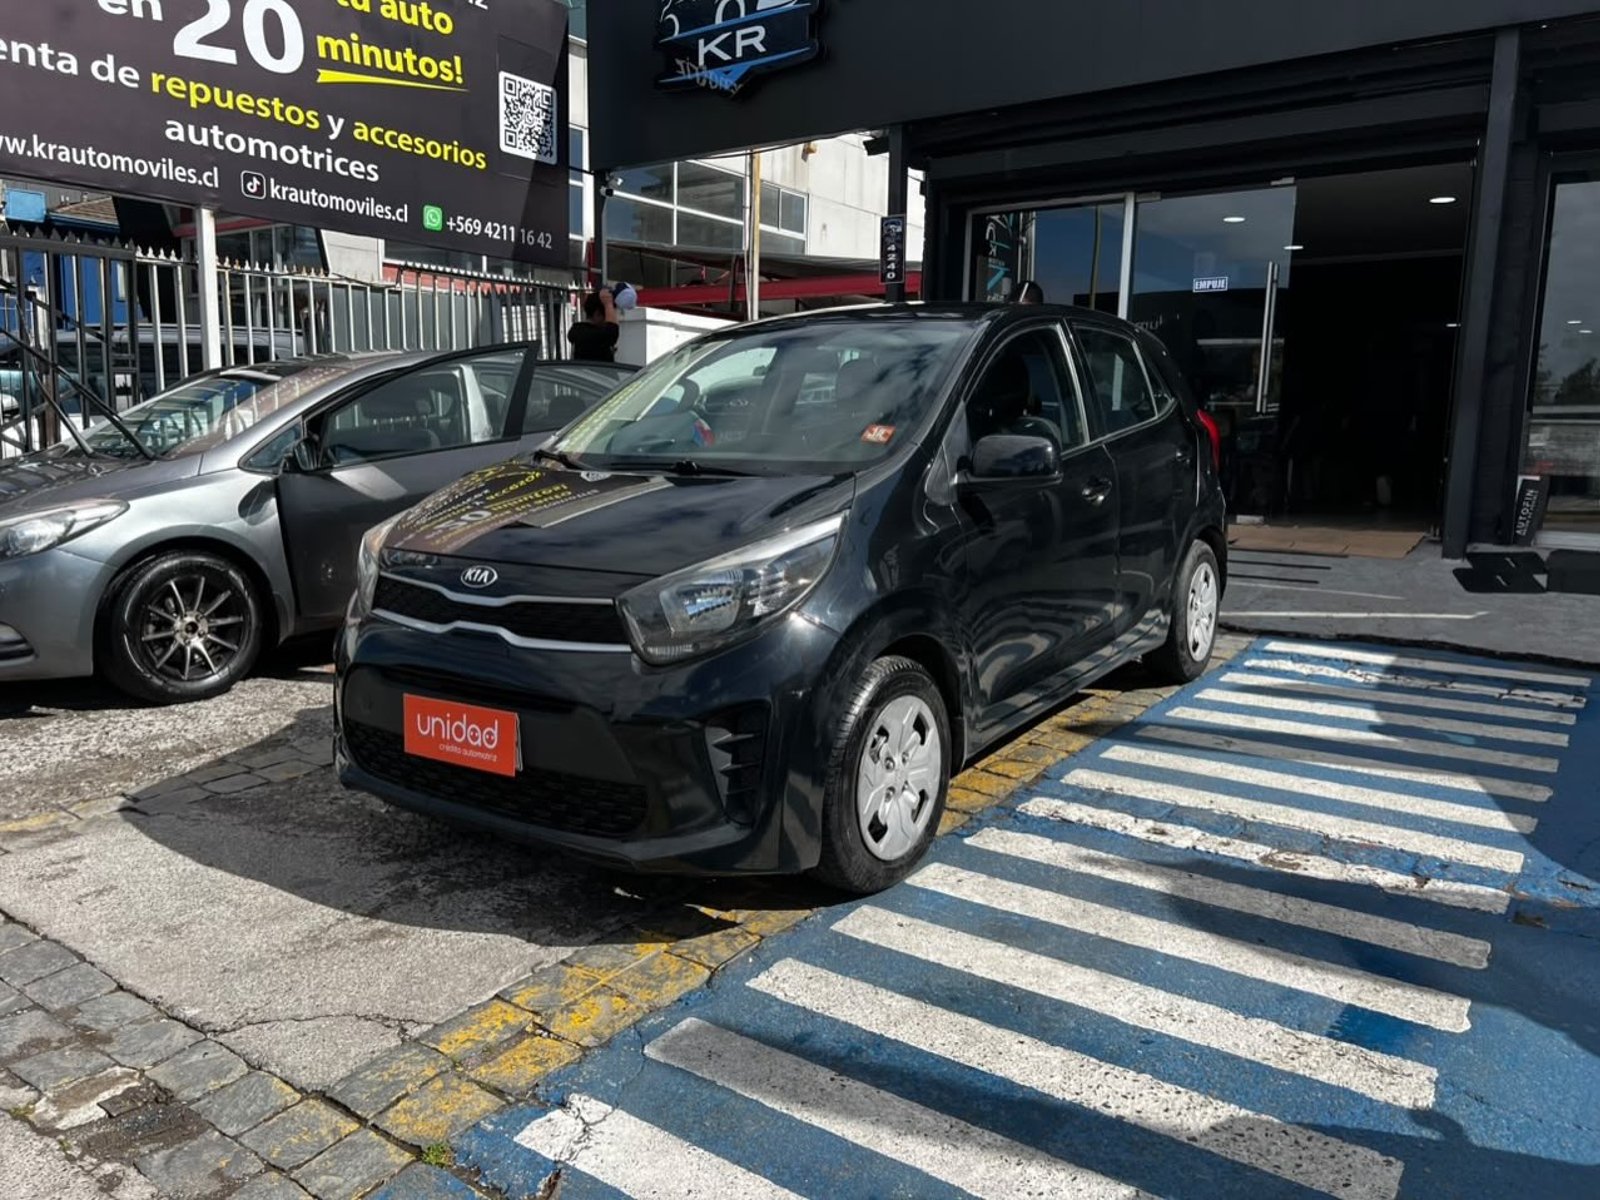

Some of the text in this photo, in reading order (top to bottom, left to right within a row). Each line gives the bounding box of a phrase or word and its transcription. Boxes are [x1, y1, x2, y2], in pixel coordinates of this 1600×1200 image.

[380, 0, 454, 34] auto
[97, 0, 463, 84] en 20 minutos!
[698, 25, 767, 67] KR
[91, 54, 140, 88] de
[151, 72, 320, 129] repuestos
[326, 114, 345, 140] y
[353, 121, 487, 170] accesorios
[0, 133, 219, 188] w.krautomoviles.cl
[165, 120, 379, 182] automotrices
[270, 178, 408, 223] krautomoviles.cl
[446, 215, 553, 249] +569 4211 16 42
[886, 243, 897, 279] 4240
[1195, 279, 1225, 290] EMPUJE
[464, 568, 489, 583] KIA
[416, 712, 499, 749] unidad
